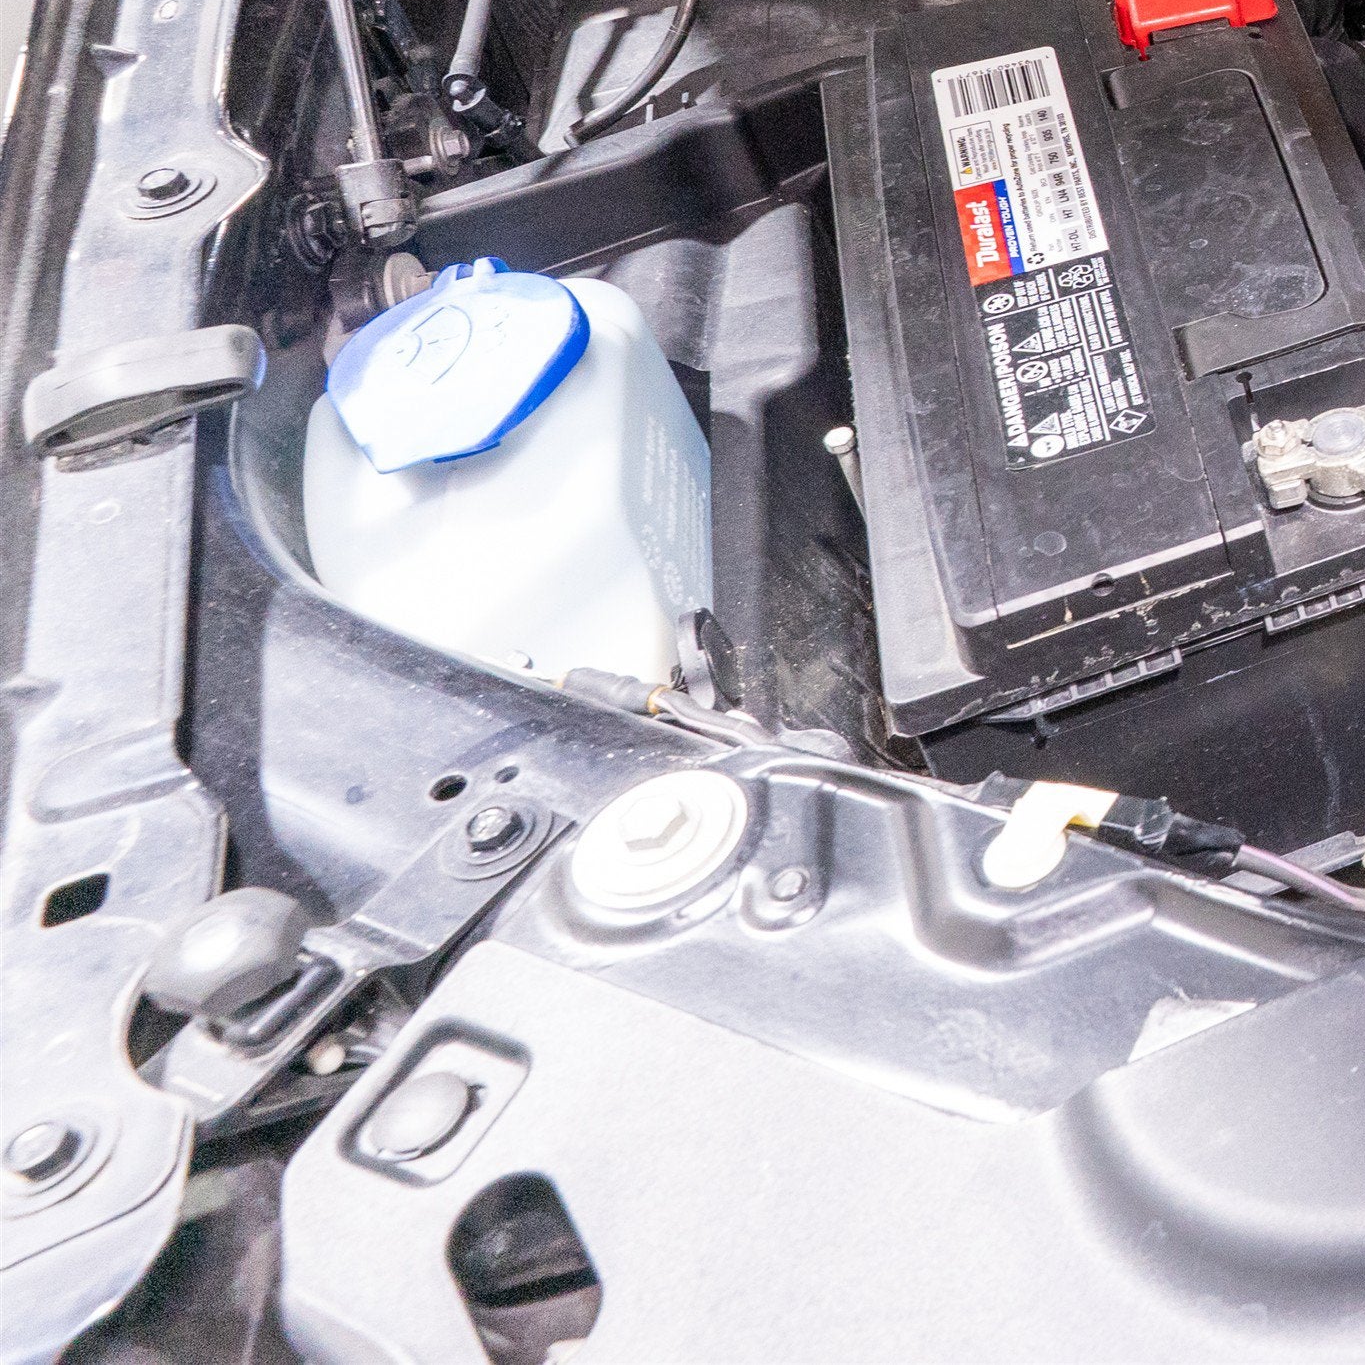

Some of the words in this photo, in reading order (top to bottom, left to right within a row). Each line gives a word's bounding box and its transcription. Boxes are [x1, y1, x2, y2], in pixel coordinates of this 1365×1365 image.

[1037, 111, 1047, 121] 140
[1003, 123, 1012, 143] recycling
[1042, 130, 1053, 141] 935
[957, 138, 970, 167] WARNING:
[1008, 145, 1017, 159] proper
[1048, 152, 1058, 164] 750
[1013, 168, 1023, 191] AutoZone
[1053, 173, 1064, 186] 94R
[1058, 189, 1069, 202] LN4
[1076, 187, 1085, 198] BEST
[998, 197, 1011, 223] TOUGH
[1021, 198, 1030, 219] batteries
[1063, 210, 1072, 218] H7
[1025, 221, 1033, 233] used
[1082, 207, 1096, 239] DISTRIBUTED
[966, 201, 1000, 267] Duralast
[1005, 225, 1019, 257] PROVEN
[1029, 234, 1037, 251] Return
[1069, 230, 1081, 251] H7-DL
[988, 323, 1025, 436] DANGER/POISON
